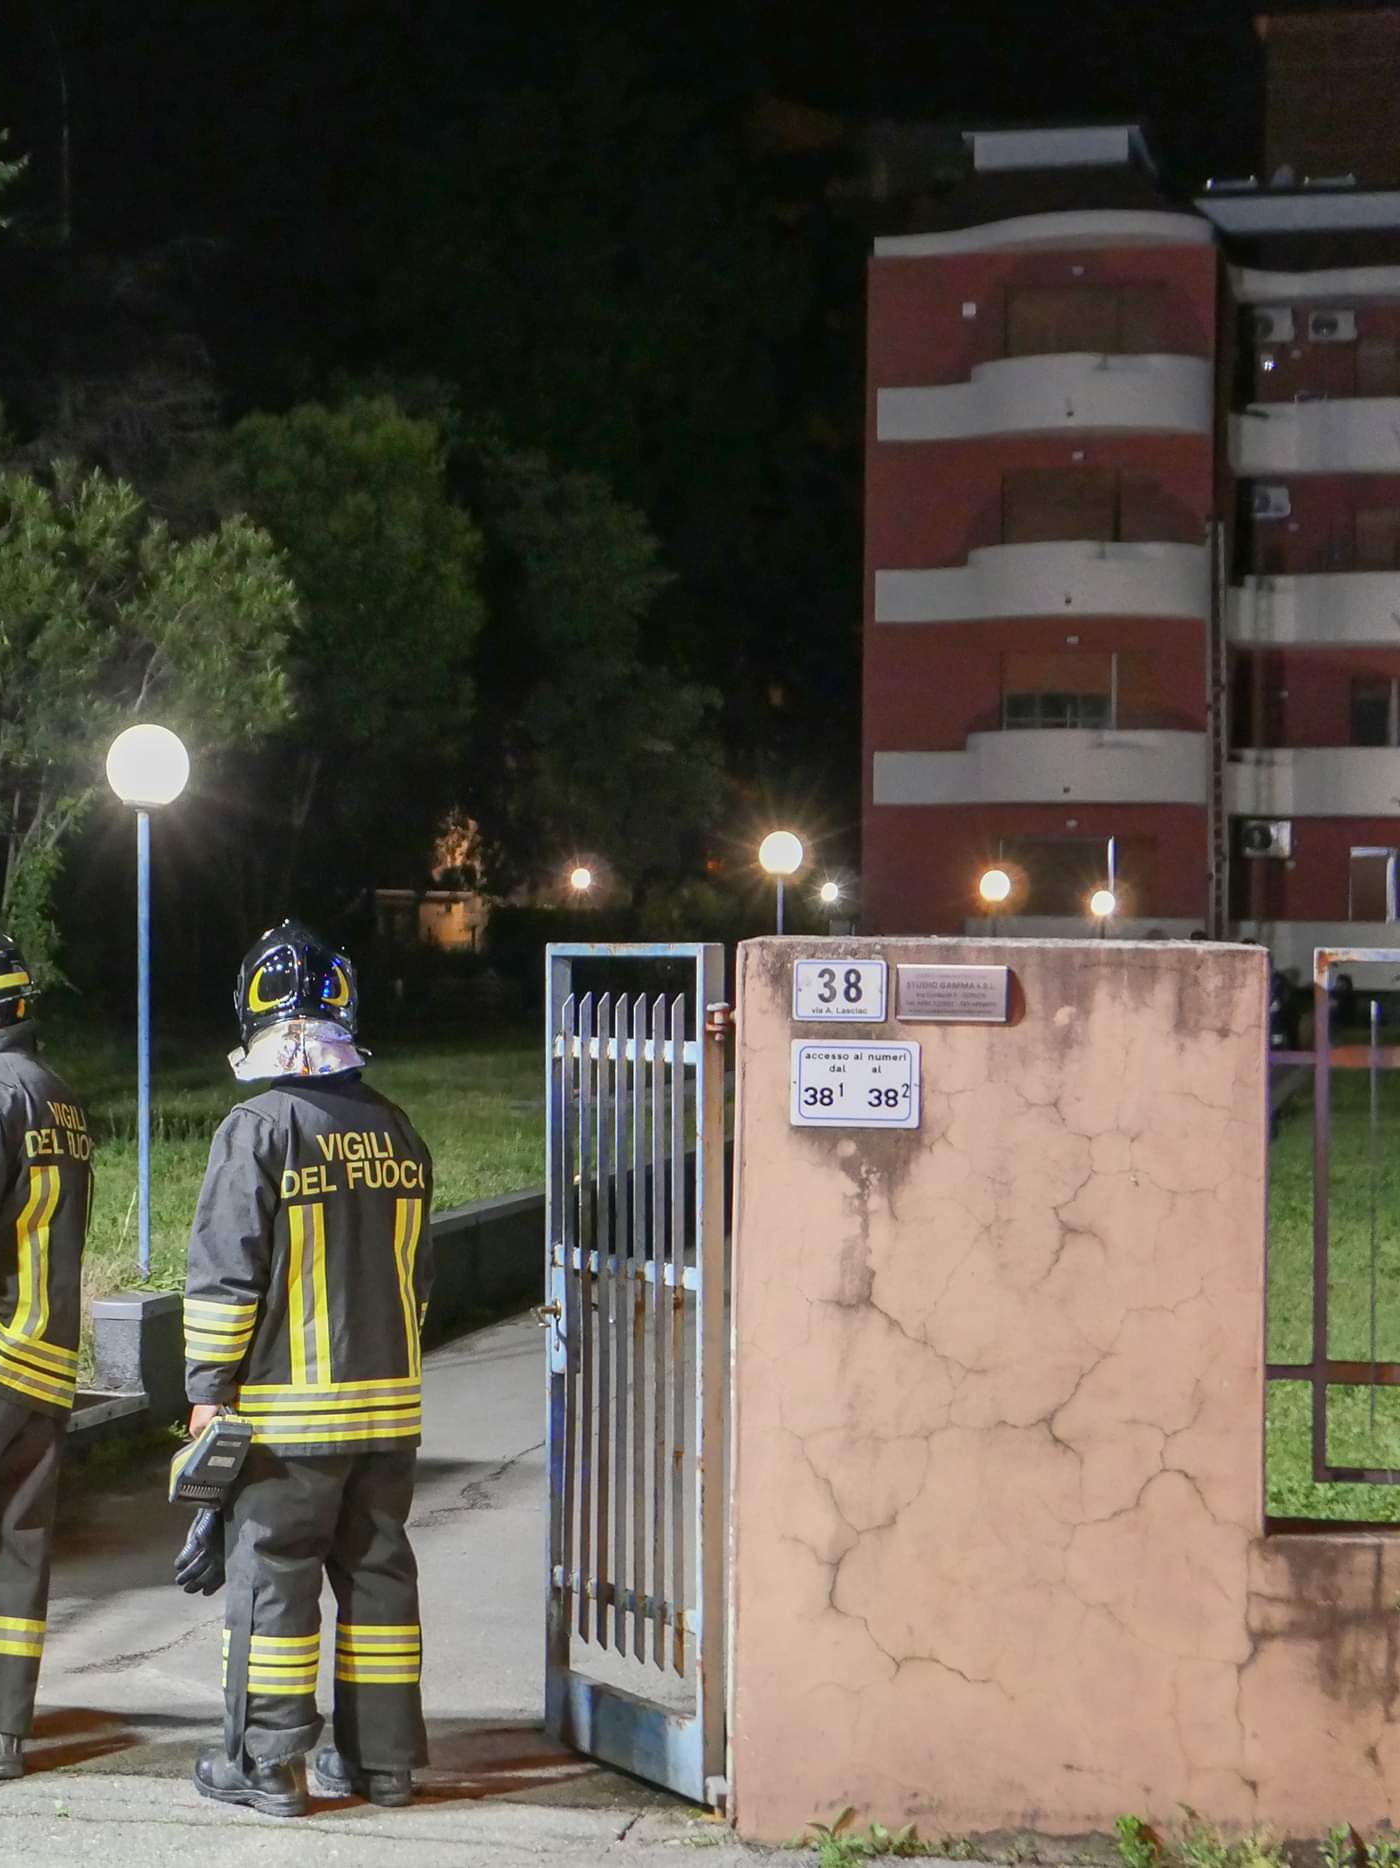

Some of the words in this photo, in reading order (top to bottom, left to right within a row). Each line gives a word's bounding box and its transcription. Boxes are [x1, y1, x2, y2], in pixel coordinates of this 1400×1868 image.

[817, 968, 863, 1003] 38
[805, 1052, 849, 1060] accesso
[867, 1053, 907, 1061] numeri
[829, 1064, 846, 1073] dal
[871, 1066, 882, 1074] al
[24, 1128, 64, 1159] DEL
[316, 1131, 393, 1162] VIGILI
[280, 1165, 337, 1199] DEL
